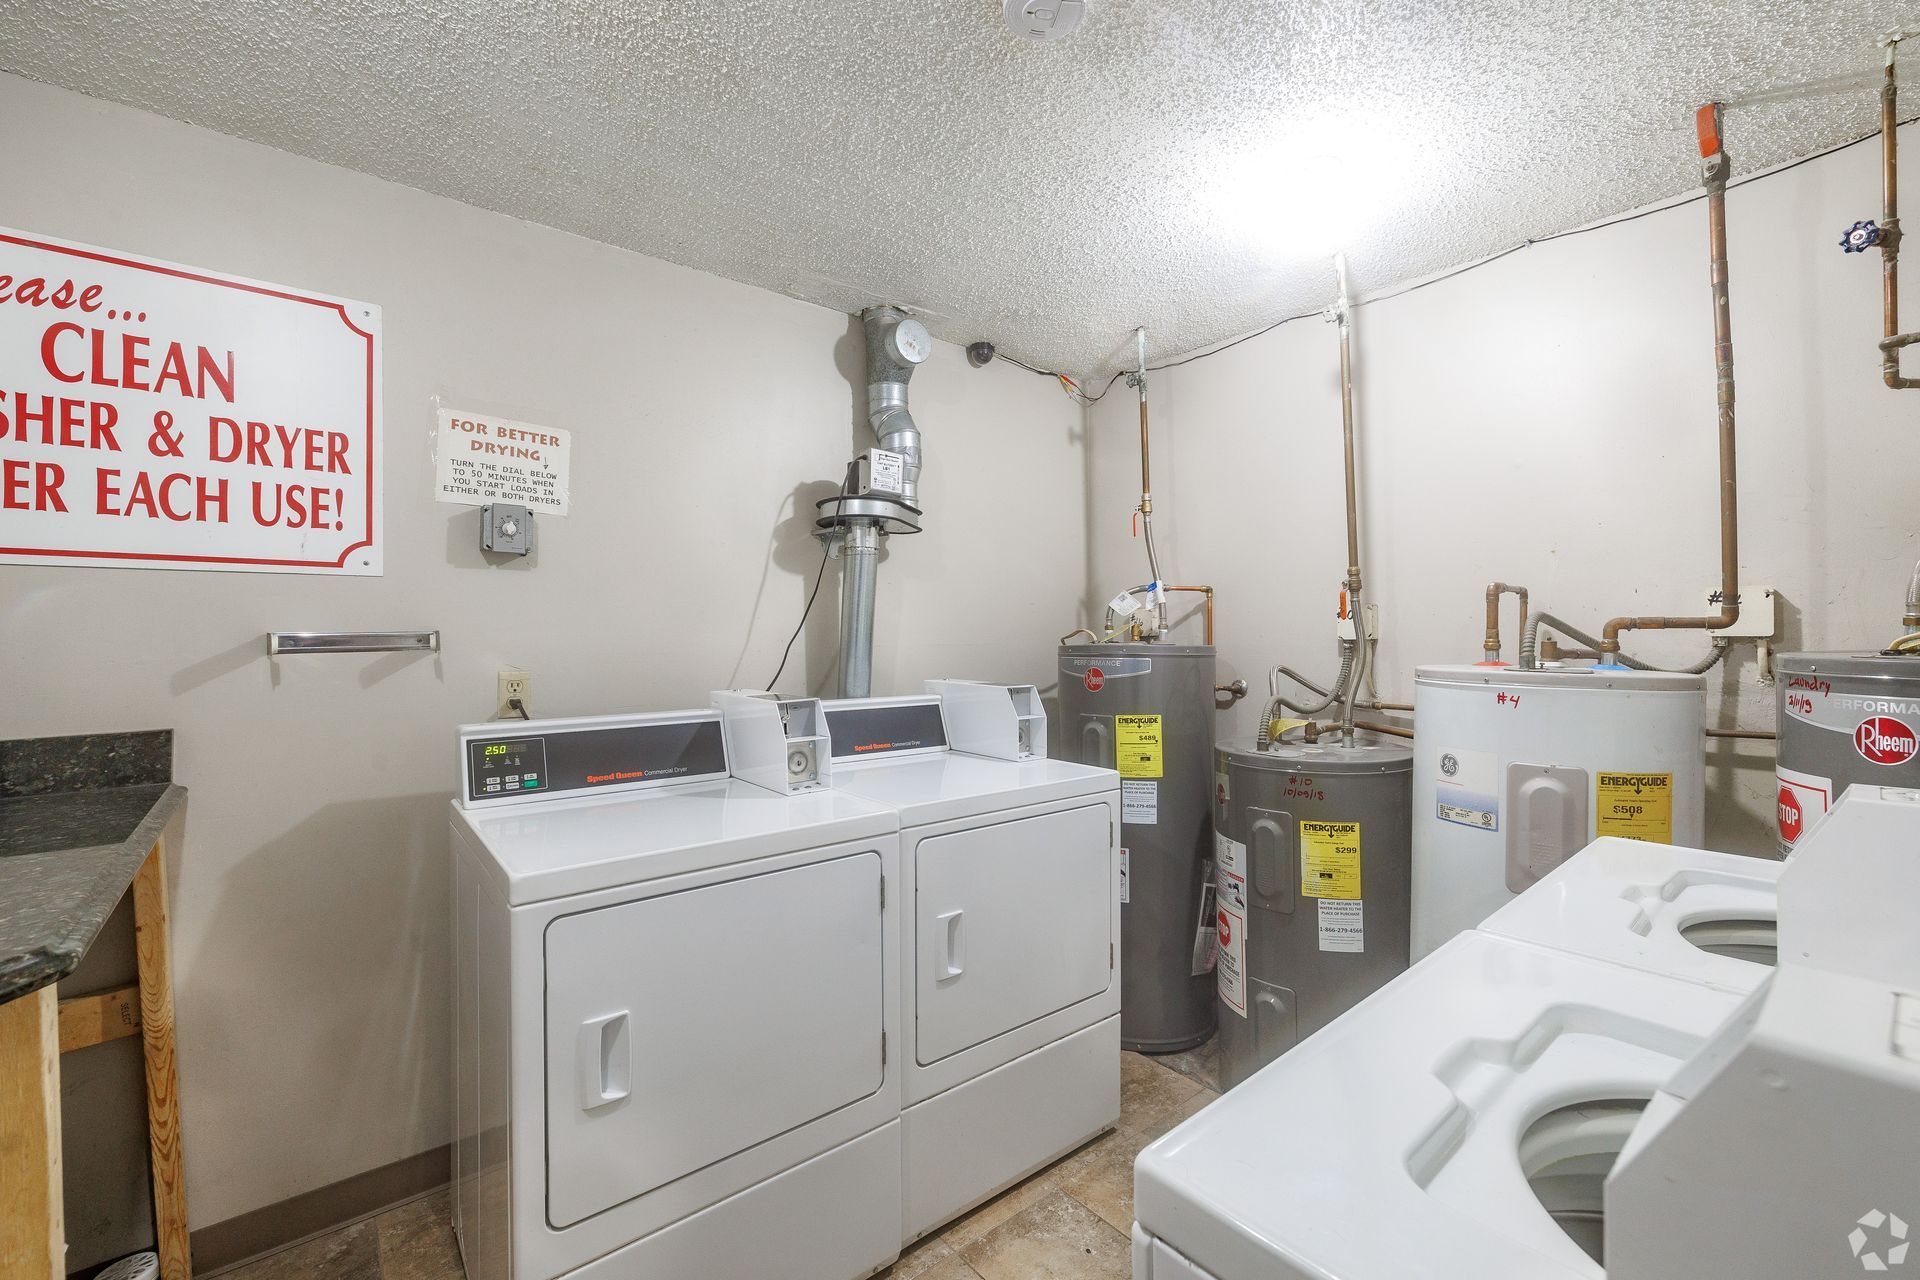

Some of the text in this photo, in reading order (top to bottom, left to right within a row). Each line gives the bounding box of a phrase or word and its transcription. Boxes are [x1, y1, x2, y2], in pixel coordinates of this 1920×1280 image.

[41, 321, 235, 403] CLEAN
[148, 410, 184, 458] &
[208, 416, 352, 475] DRYER
[450, 418, 560, 447] FOR BETTER
[470, 440, 540, 461] DRYING
[450, 458, 557, 480] TURN THE DIAL BELOW
[452, 477, 470, 485] YOU
[476, 480, 505, 490] START
[510, 486, 537, 494] LOADS
[488, 473, 527, 484] MINUTES
[532, 480, 554, 488] WHEN
[96, 467, 229, 523] EACH
[251, 481, 344, 531] USE!
[444, 485, 478, 495] EITHER
[502, 493, 524, 501] BOTH
[529, 496, 561, 505] DRYERS
[1788, 676, 1830, 697] Laundry
[1497, 692, 1520, 708] #4
[1861, 718, 1914, 756] Rheem
[485, 745, 506, 755] 2.50
[587, 773, 614, 783] Speed
[616, 771, 642, 779] Queen
[644, 768, 673, 776] Commercial
[1600, 776, 1668, 786] ENERGYGUIDE
[1613, 805, 1643, 814] $508
[1779, 802, 1798, 826] STOP
[1304, 824, 1356, 832] ENERGYGUIDE
